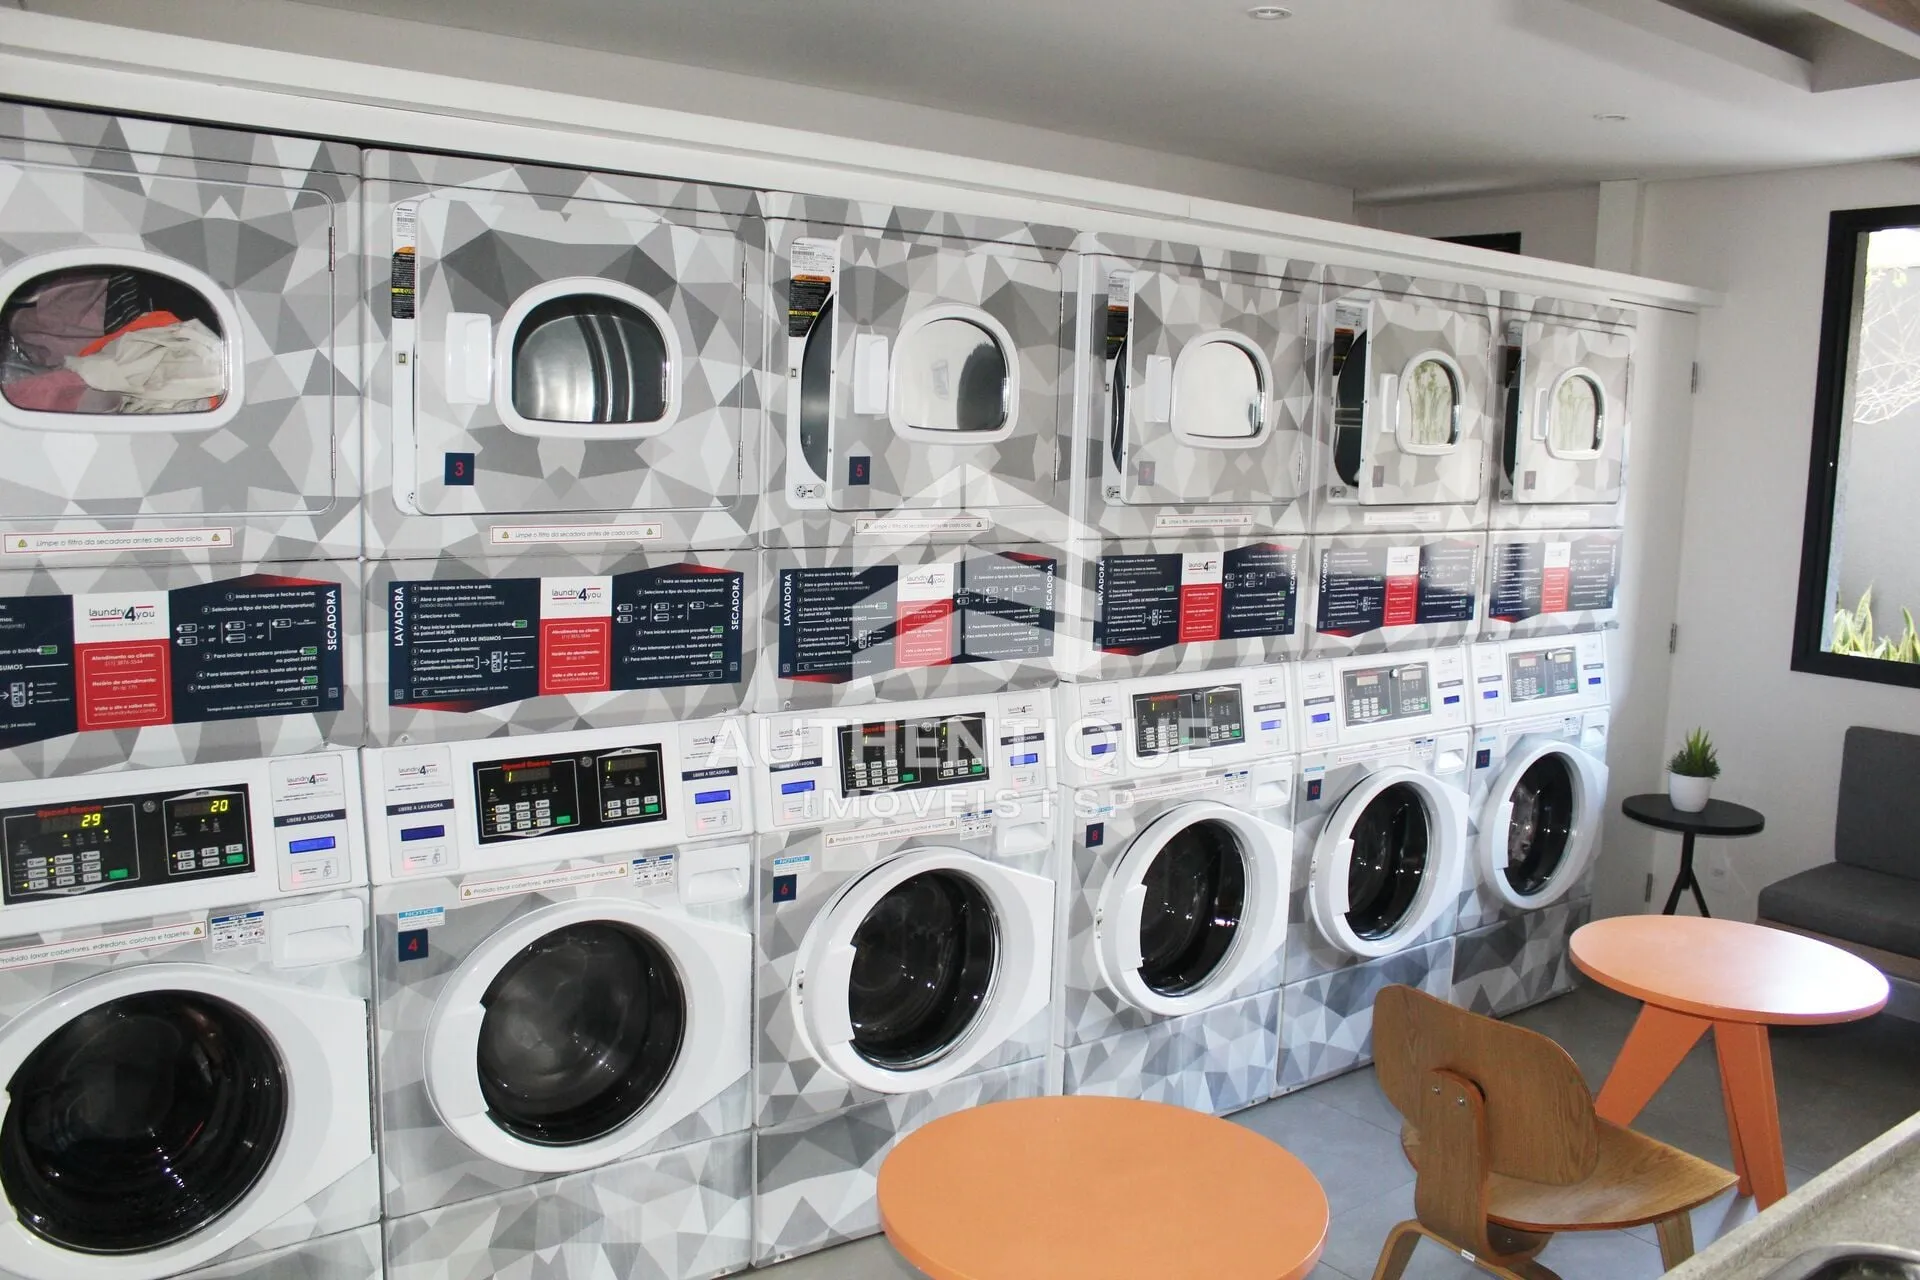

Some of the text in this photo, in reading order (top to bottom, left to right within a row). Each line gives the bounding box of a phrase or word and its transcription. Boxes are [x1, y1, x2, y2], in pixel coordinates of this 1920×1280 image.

[455, 461, 464, 477] 3
[856, 464, 863, 477] 5
[552, 588, 601, 601] laundry4you
[732, 578, 740, 630] SECADORA
[89, 606, 155, 622] laundry4you
[327, 590, 337, 650] SECADORA
[395, 587, 403, 646] LAVADORA
[1311, 785, 1319, 795] 10
[211, 800, 228, 812] 20
[82, 813, 101, 827] 29
[1092, 830, 1098, 840] 8
[780, 884, 788, 894] 6
[405, 908, 437, 916] NOTICE
[408, 937, 418, 952] 4
